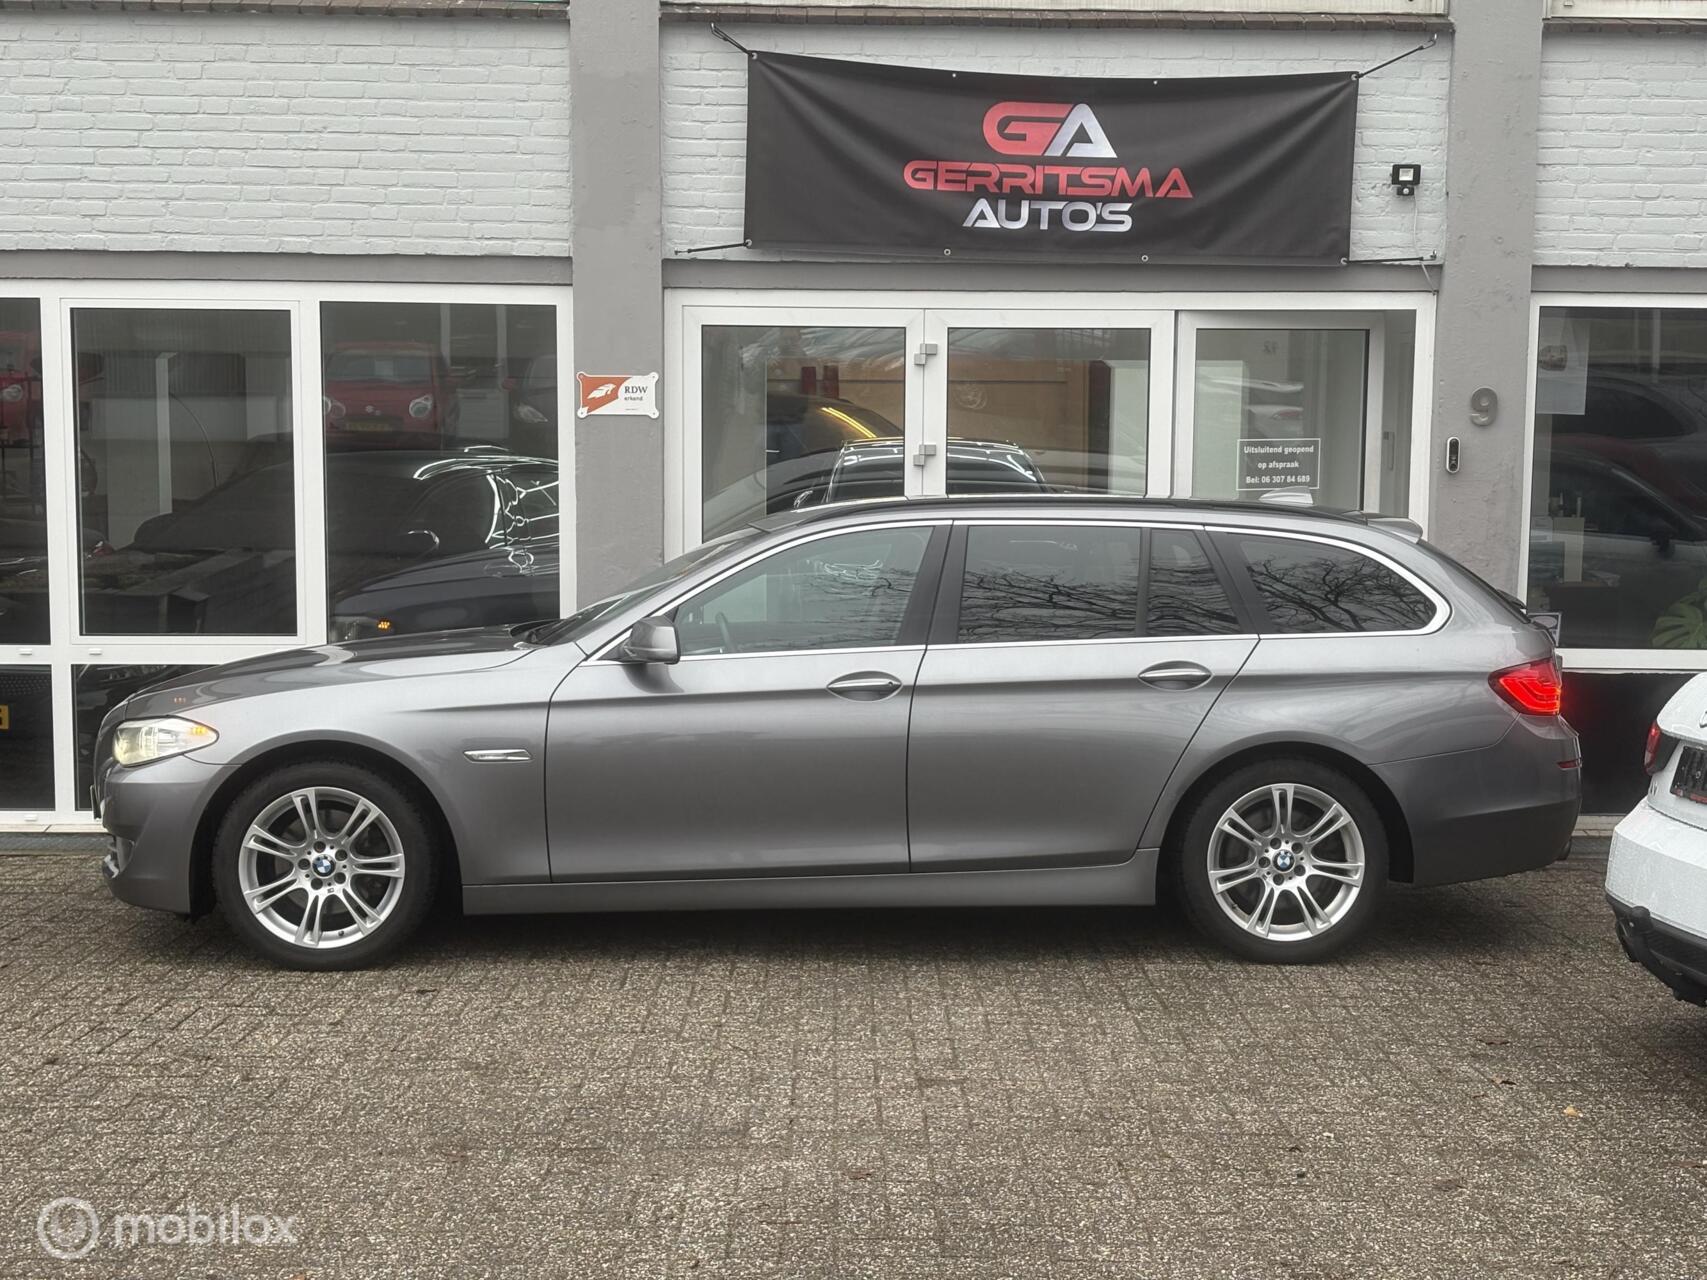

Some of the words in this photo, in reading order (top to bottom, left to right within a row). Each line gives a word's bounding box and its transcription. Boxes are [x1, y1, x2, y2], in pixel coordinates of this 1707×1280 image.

[982, 101, 1118, 158] GA
[903, 160, 1193, 198] GERRITSMA
[962, 198, 1133, 233] AUTO'S
[624, 386, 648, 394] RDW
[1470, 386, 1498, 426] 9
[1243, 445, 1282, 454] Uitsluitend
[1284, 445, 1314, 455] geopend
[1257, 462, 1267, 470] op
[1268, 460, 1299, 470] afspraak
[1261, 475, 1271, 483] 06
[1272, 475, 1285, 483] 307
